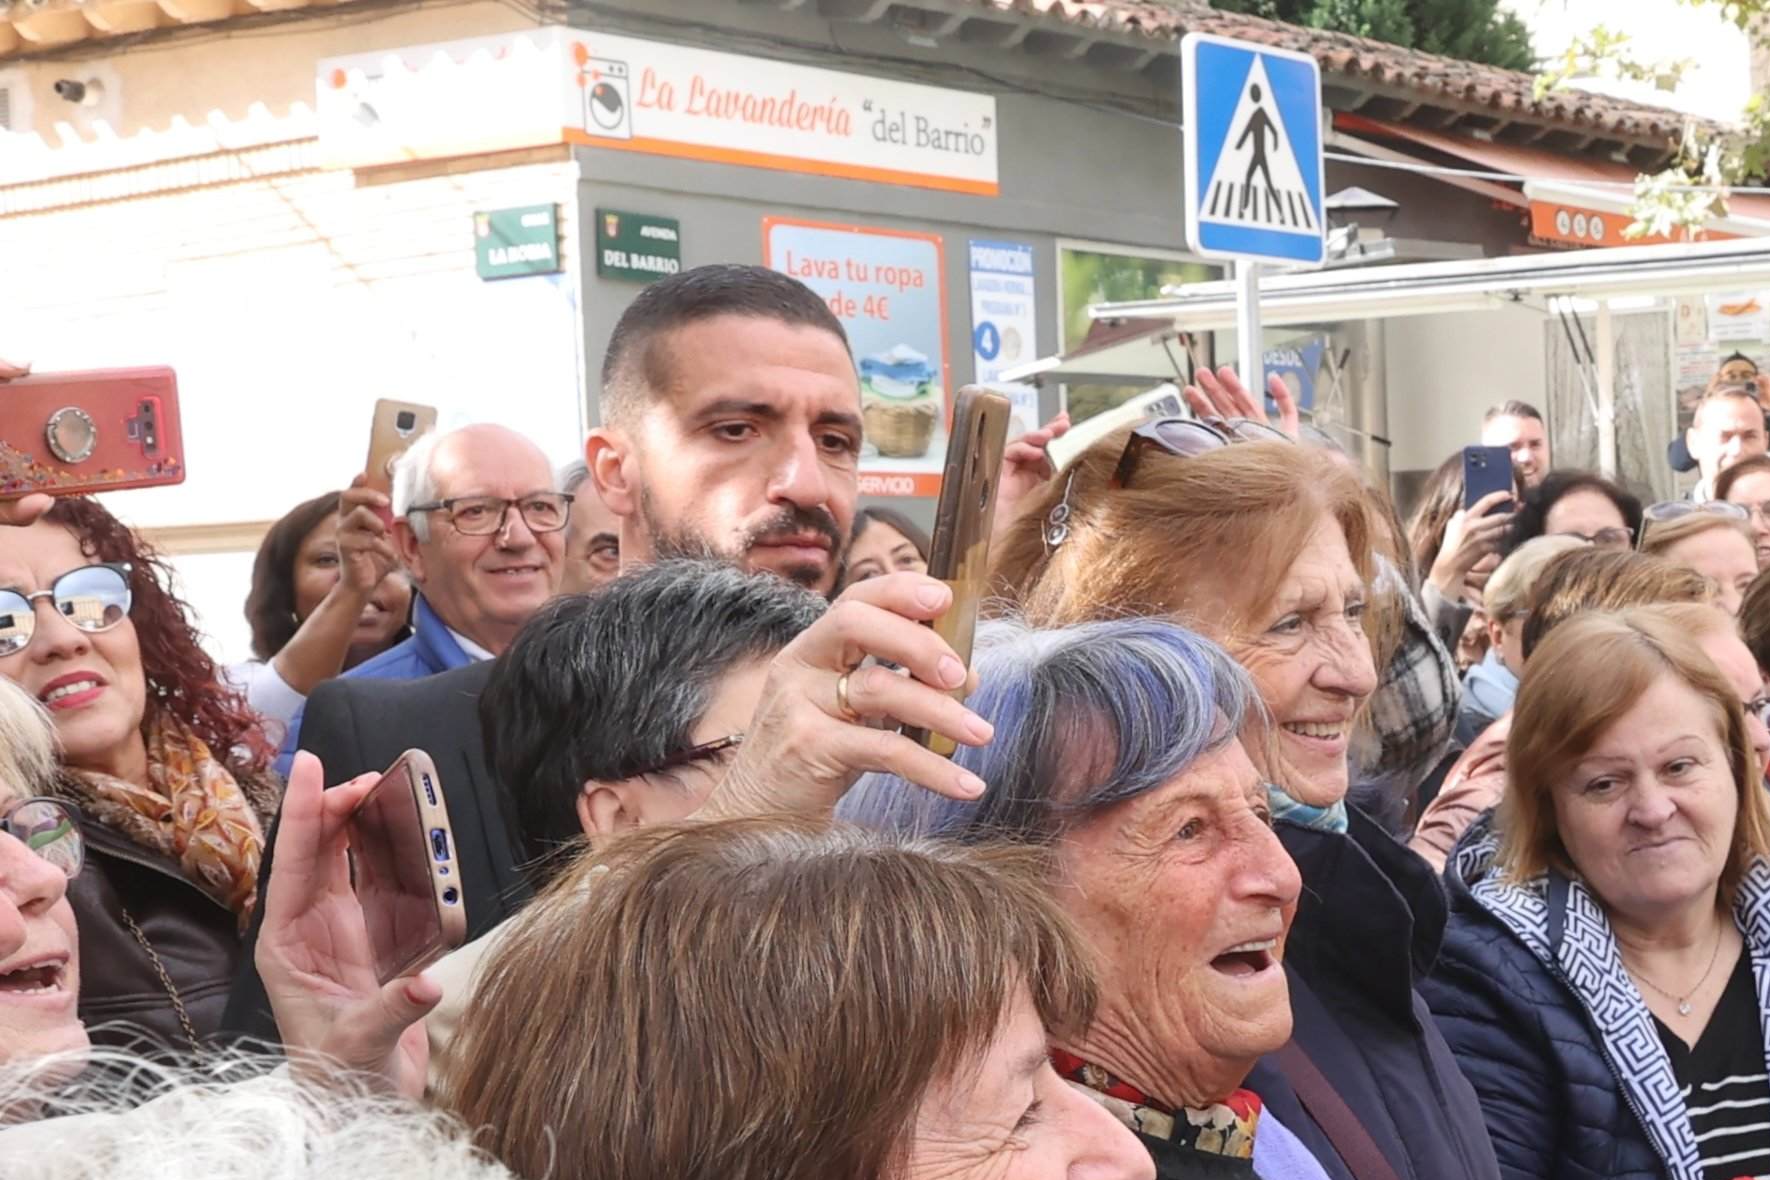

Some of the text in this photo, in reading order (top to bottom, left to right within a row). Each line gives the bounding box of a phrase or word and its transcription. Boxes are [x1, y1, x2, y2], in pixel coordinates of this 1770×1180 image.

[636, 67, 676, 111] La
[684, 76, 854, 138] Lavandería
[604, 249, 680, 274] DEL BARRIO
[786, 250, 924, 292] Lava tu ropa
[863, 295, 890, 320] 4€
